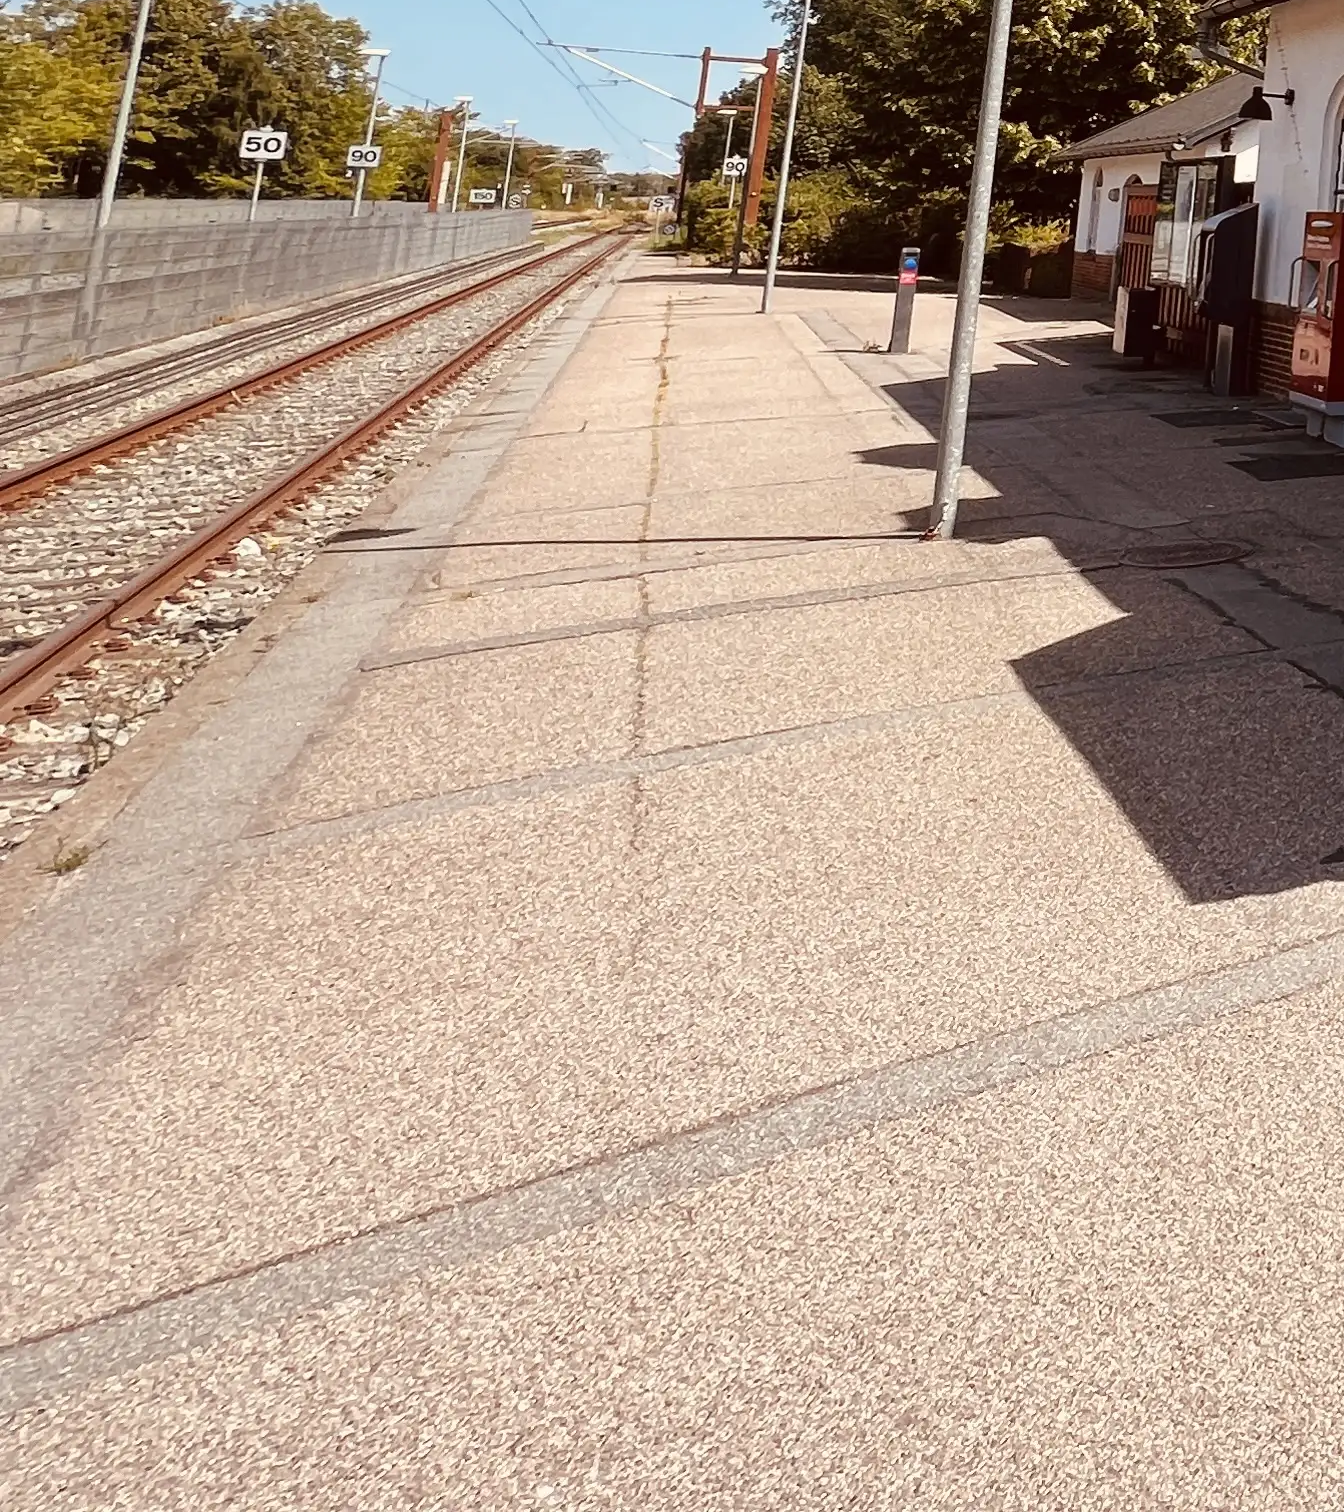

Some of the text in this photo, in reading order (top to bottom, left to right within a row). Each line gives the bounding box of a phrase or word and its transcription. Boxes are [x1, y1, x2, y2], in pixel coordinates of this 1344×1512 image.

[245, 136, 282, 153] 50
[351, 149, 377, 163] 90
[726, 161, 745, 172] 90
